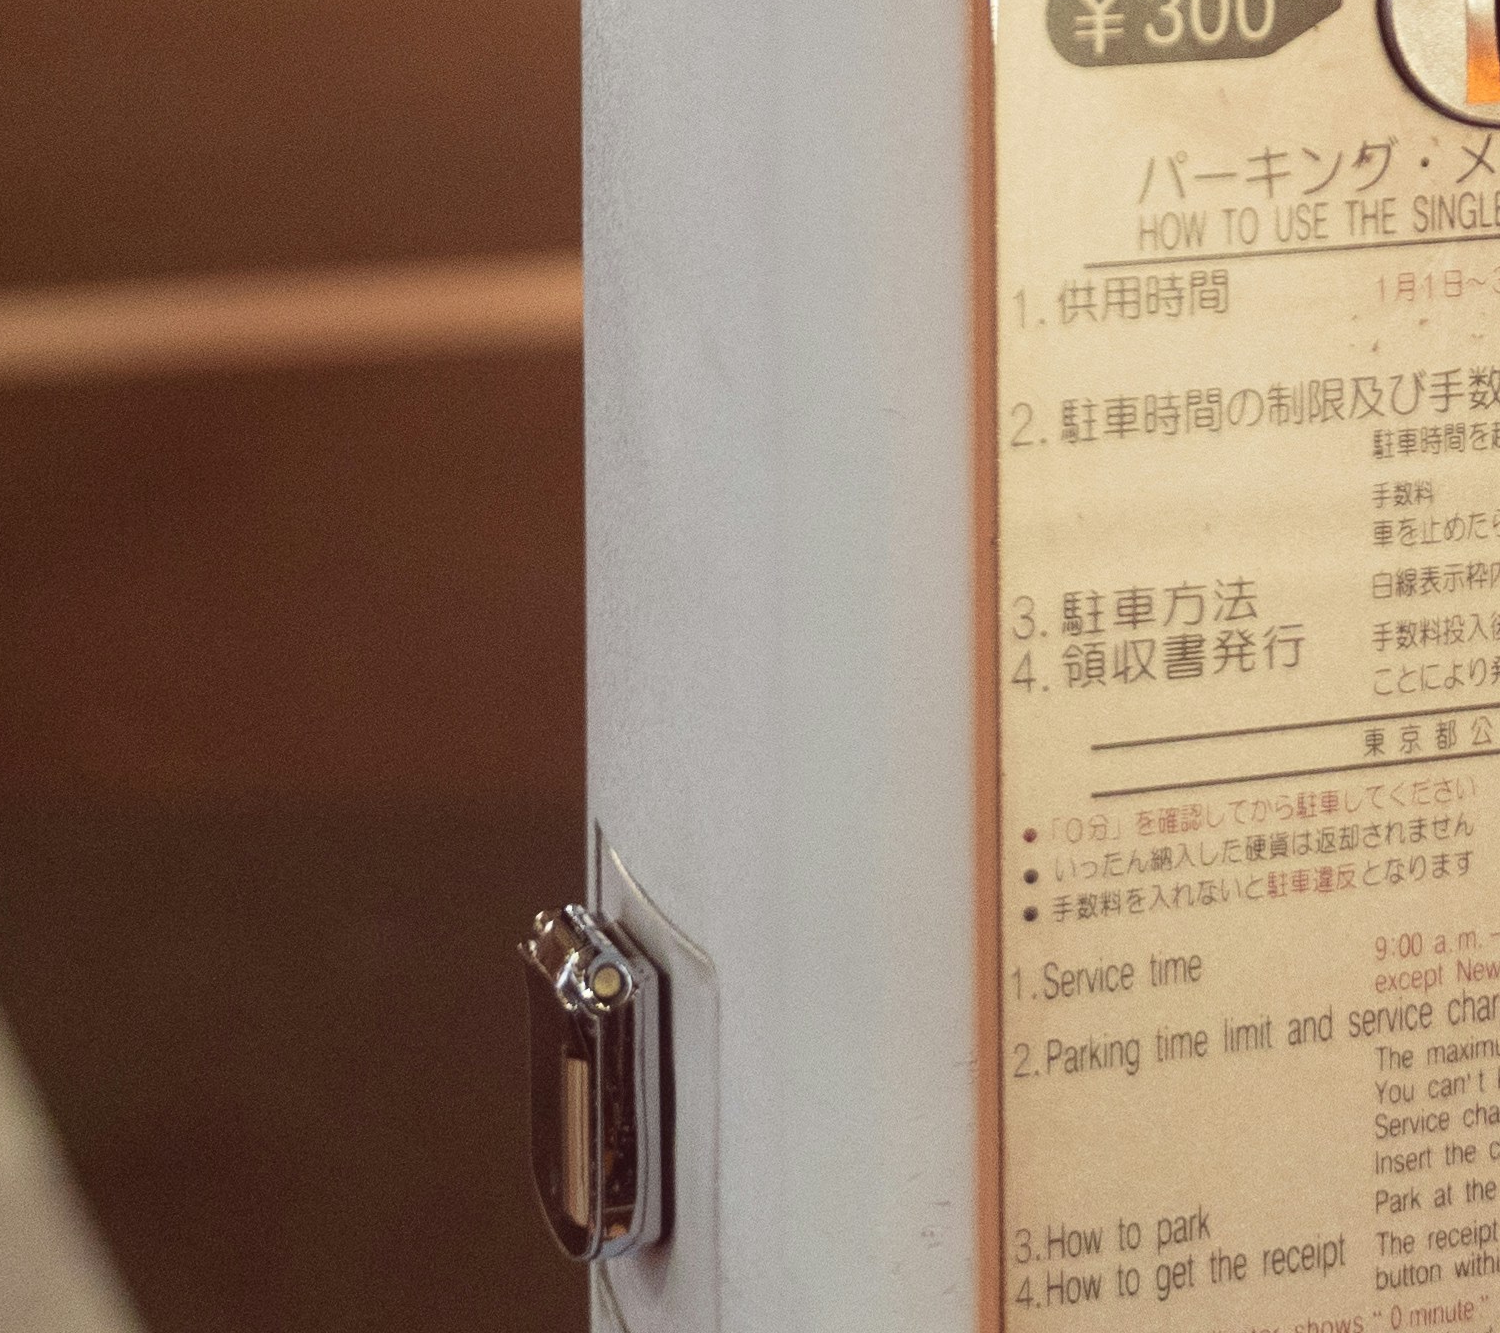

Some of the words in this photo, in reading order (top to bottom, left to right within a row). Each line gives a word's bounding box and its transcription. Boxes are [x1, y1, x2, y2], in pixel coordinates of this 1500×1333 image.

[1138, 212, 1206, 251] HOW
[1222, 207, 1259, 246] TO
[1275, 202, 1329, 244] USE
[1345, 197, 1396, 236] THE
[1372, 482, 1435, 510] 手数料
[1375, 932, 1423, 962] 9:00
[1149, 954, 1203, 988] time
[1374, 964, 1443, 994] except
[1456, 959, 1500, 983] New
[1155, 1029, 1208, 1063] time
[1223, 1015, 1273, 1053] limit
[1287, 1005, 1333, 1047] and
[1348, 1001, 1433, 1039] service
[1375, 1046, 1414, 1071] The
[1375, 1081, 1415, 1106] You
[1374, 1112, 1450, 1141] Service
[1374, 1147, 1432, 1175] Insert
[1445, 1143, 1477, 1166] the
[1375, 1188, 1421, 1215] Park
[1434, 1184, 1452, 1208] at
[1465, 1179, 1497, 1204] the
[1117, 1218, 1142, 1252] to
[1157, 1204, 1211, 1252] park
[1376, 1231, 1415, 1256] The
[1427, 1220, 1498, 1251] receipt
[1116, 1265, 1140, 1298] to
[1155, 1254, 1195, 1299] get
[1209, 1248, 1247, 1284] the
[1263, 1234, 1346, 1277] receipt
[1375, 1264, 1442, 1291] button
